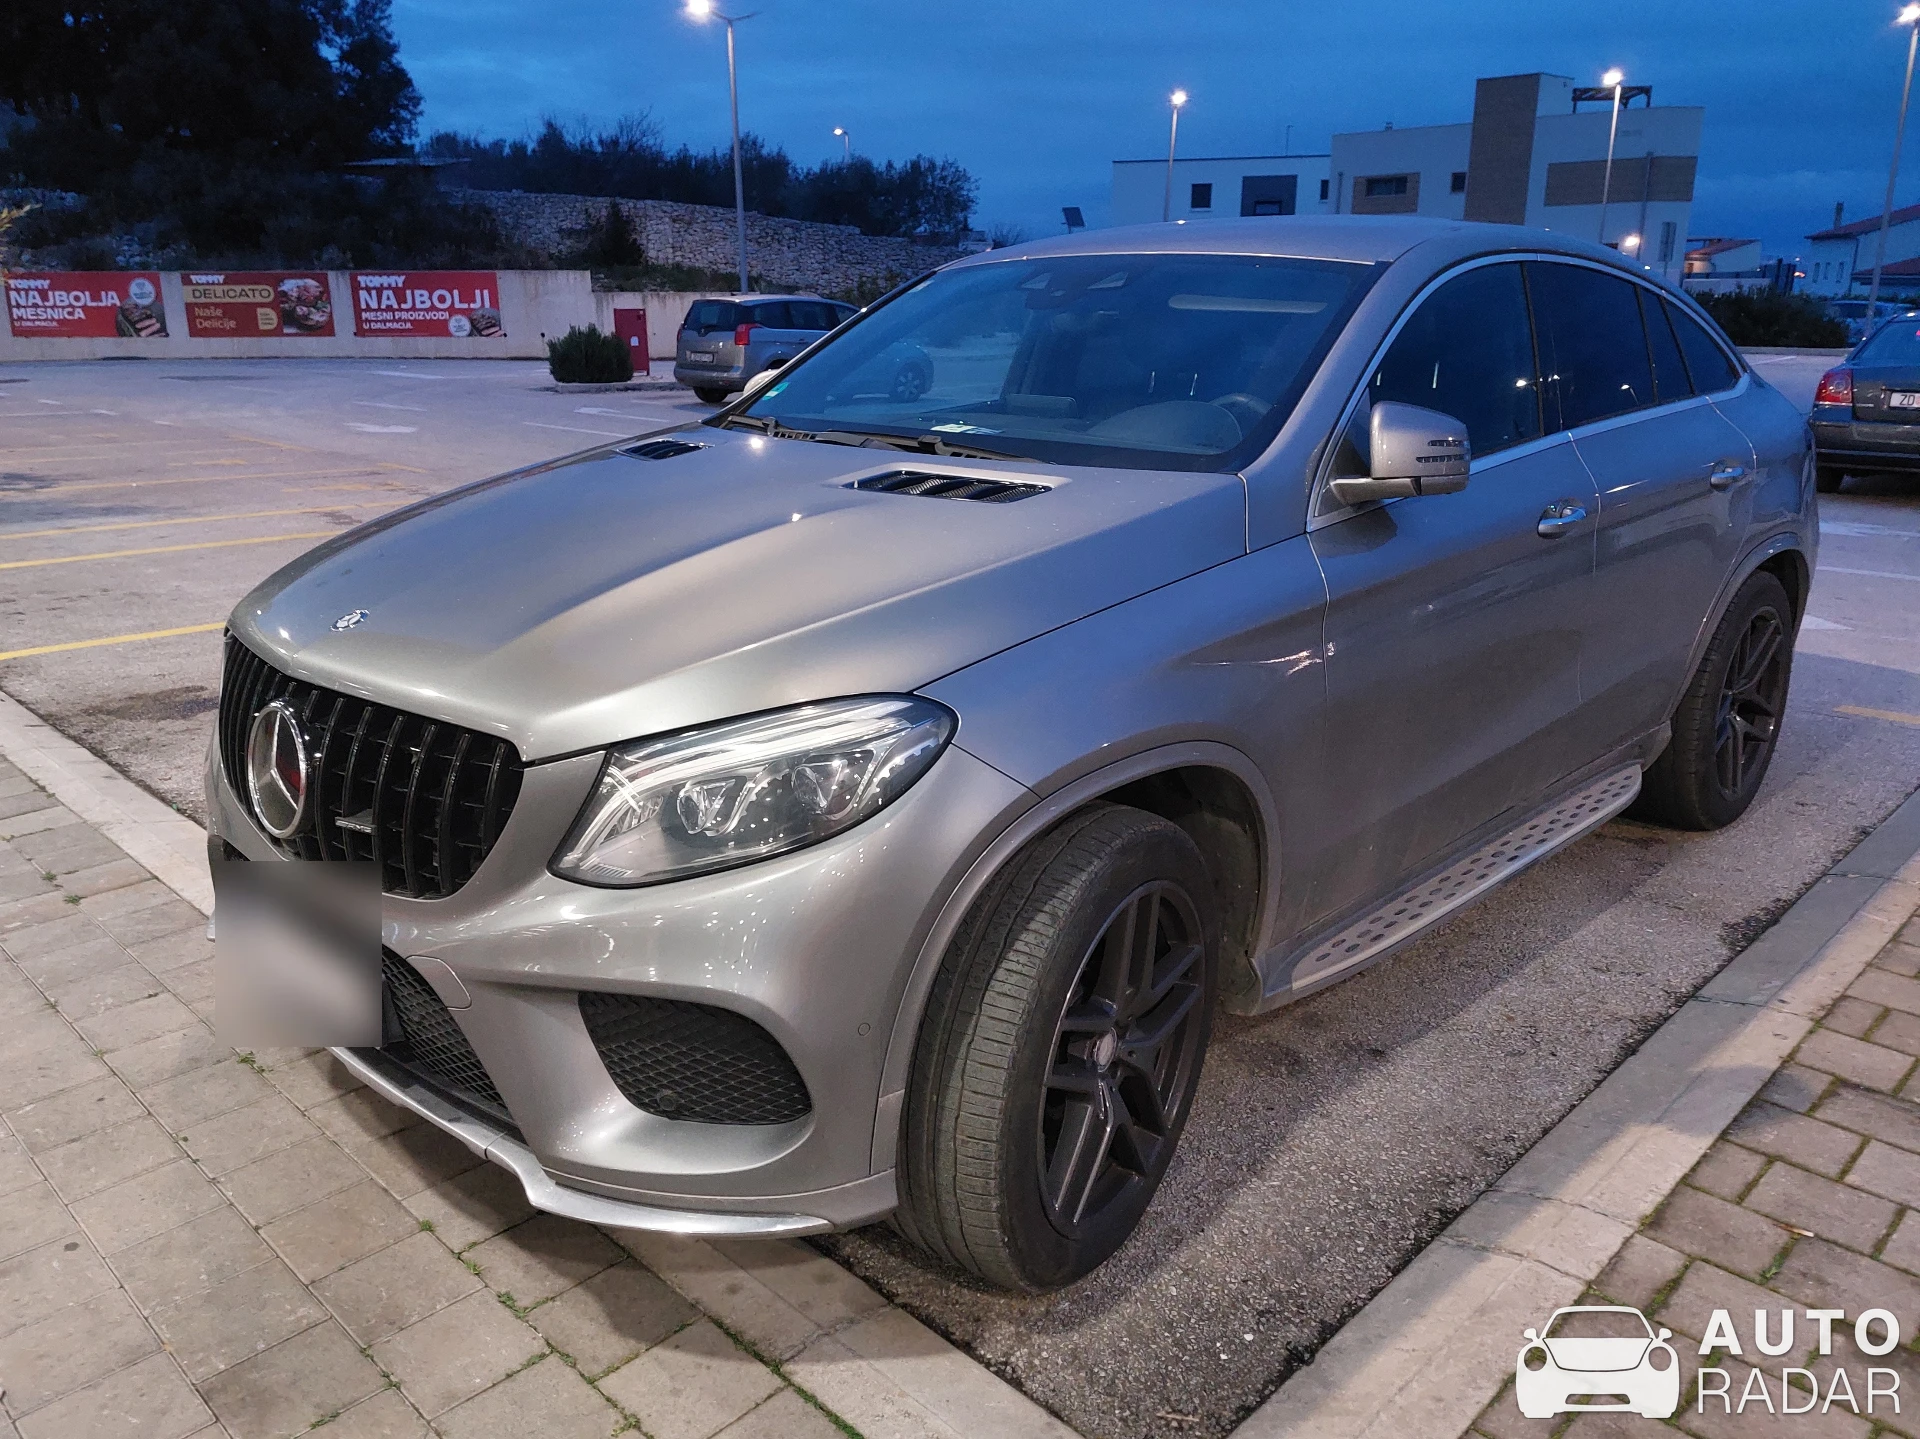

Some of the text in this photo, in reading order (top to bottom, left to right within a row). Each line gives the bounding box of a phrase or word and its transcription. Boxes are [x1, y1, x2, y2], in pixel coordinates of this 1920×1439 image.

[357, 275, 406, 287] TOMMY
[9, 290, 121, 307] NAJBOLJA
[192, 288, 271, 300] DELICATO
[358, 289, 491, 309] NAJBOLJI
[12, 308, 86, 320] MESNICA
[195, 306, 223, 317] Naše
[361, 311, 449, 320] MESNI PROIZVODI
[196, 318, 237, 330] Delicije
[1900, 394, 1915, 406] ZD
